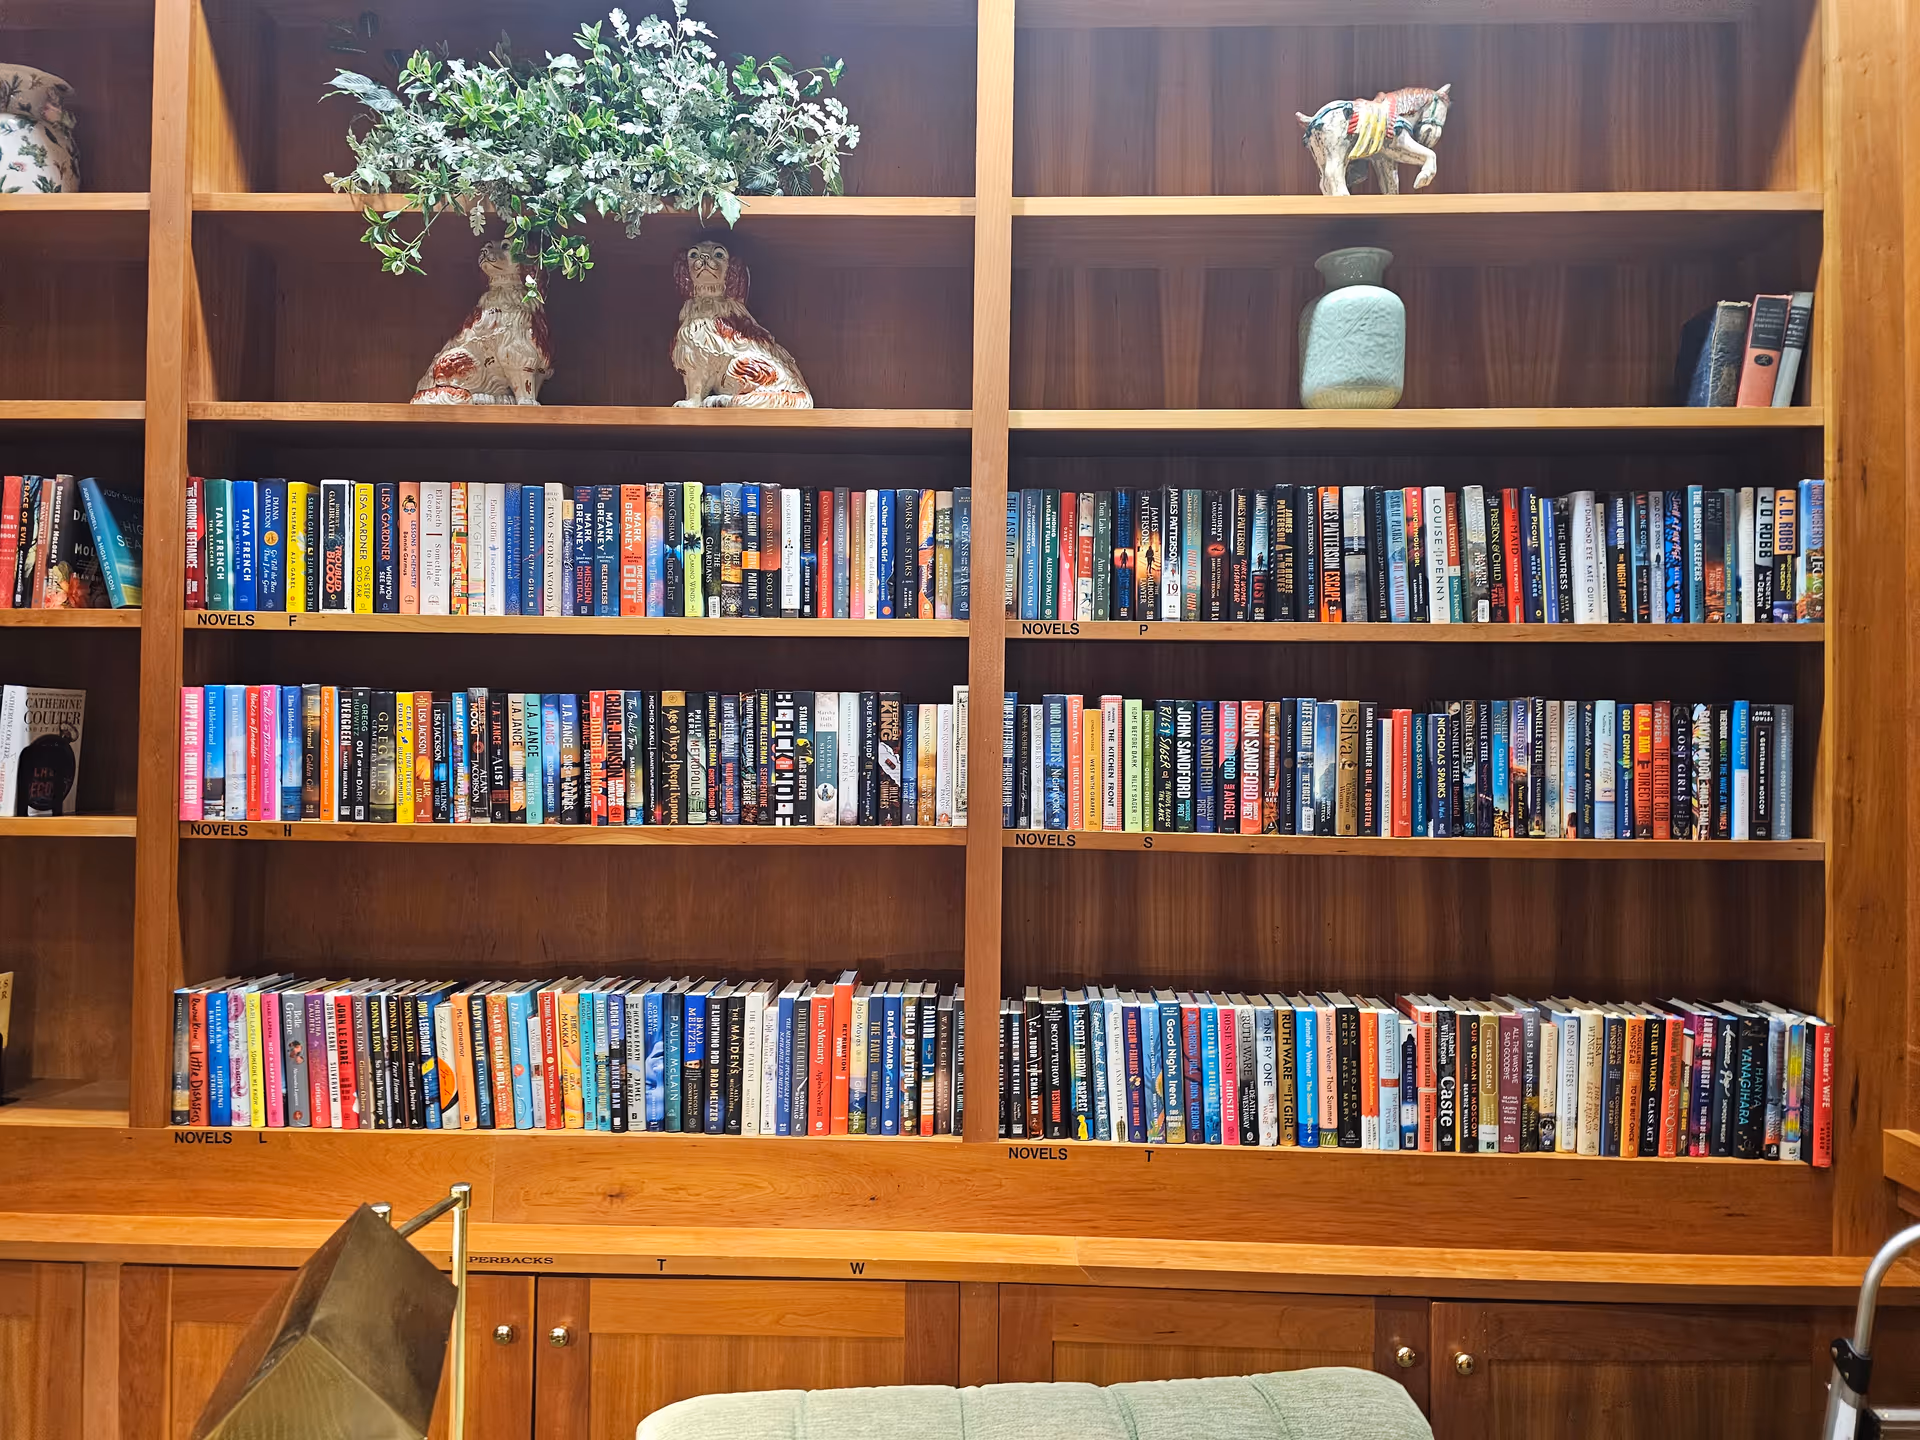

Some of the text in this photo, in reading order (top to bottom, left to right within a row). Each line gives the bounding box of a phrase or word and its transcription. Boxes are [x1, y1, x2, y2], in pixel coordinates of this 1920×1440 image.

[55, 486, 63, 524] DAUGHTER
[82, 487, 98, 531] JUDY BLUNDELL
[186, 499, 197, 530] BOURNE
[382, 488, 390, 560] LISA GARDNER
[1433, 498, 1442, 544] LOUISE
[1779, 496, 1793, 551] J. D. ROBB
[186, 532, 197, 568] DEFIANCE
[1323, 492, 1340, 602] JAMES PATTERSON ESCAPE
[1510, 525, 1519, 554] MAID
[97, 541, 116, 591] HIGH SEASON
[326, 551, 334, 593] BLOOD
[624, 565, 636, 602] OUT
[1187, 549, 1196, 610] RUN ROSE RUN
[1559, 543, 1567, 589] HUNTRESS
[1617, 563, 1625, 586] NIGHT
[1811, 556, 1824, 600] LEGACY
[197, 614, 298, 626] NOVELS F
[1022, 623, 1148, 636] NOVELS P
[24, 711, 81, 725] COULTER
[25, 697, 82, 709] CATHERINE
[185, 694, 198, 744] HAPPY PLACE
[470, 703, 479, 734] MOON
[881, 701, 892, 740] KING
[1738, 709, 1747, 735] nancy
[607, 694, 623, 777] CRAIG JOHNSON
[1050, 703, 1061, 762] NORA ROBERTS
[1160, 706, 1172, 768] RILEY SAGER
[1340, 714, 1358, 755] Silva
[378, 712, 388, 796] GREG ILES
[690, 740, 700, 796] METROPOLIS
[1177, 707, 1191, 798] JOHN SANDFORD
[184, 752, 197, 804] EMILY HENRY
[1224, 791, 1235, 820] ANGEL
[190, 824, 292, 836] NOVELS H
[1016, 833, 1153, 848] NOVELS S
[285, 1003, 294, 1034] Greene
[472, 1001, 480, 1020] LADY
[711, 1011, 720, 1064] LIGHTNING ROD
[730, 1025, 739, 1074] MAIDENS
[815, 1005, 826, 1064] Liane Moriarty
[904, 1006, 915, 1089] HELLO BEAUTIFUL
[1050, 1024, 1058, 1051] SCOTT
[1282, 1014, 1292, 1080] RUTH WARE
[670, 1016, 678, 1101] PAULA McLAIN
[1167, 1049, 1176, 1077] Night,
[710, 1069, 720, 1121] BRAD MELTZER
[1078, 1081, 1087, 1112] SUSPECT
[1169, 1081, 1178, 1106] Irene
[1441, 1076, 1454, 1126] Caste
[1739, 1048, 1752, 1124] YANAGIHARA
[1754, 1068, 1763, 1107] HANYA
[1052, 1090, 1061, 1122] TESTIMONY
[1284, 1106, 1293, 1130] GIRL
[174, 1132, 268, 1144] NOVELS L
[1008, 1147, 1154, 1162] NOVELS T
[448, 1256, 554, 1265] PERBACKS
[656, 1258, 667, 1272] T
[850, 1262, 866, 1275] W
